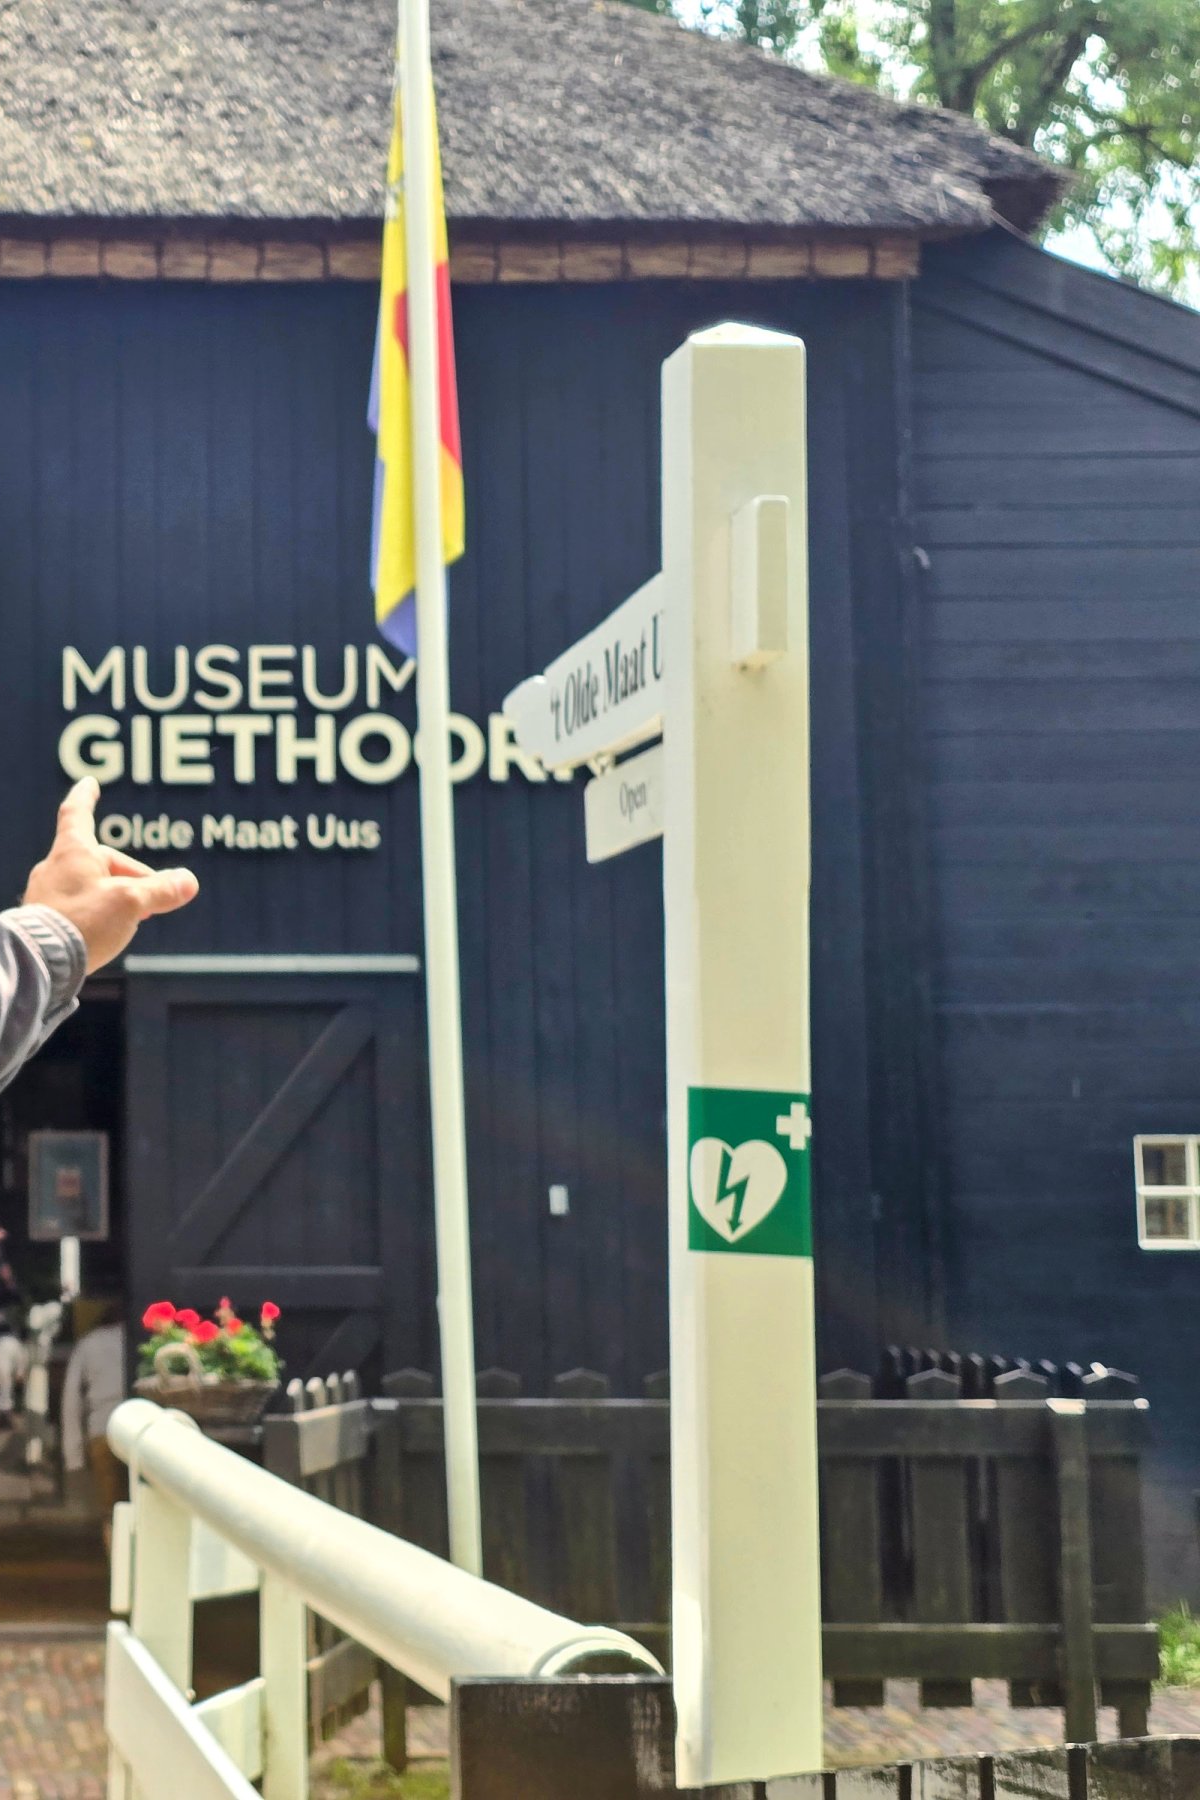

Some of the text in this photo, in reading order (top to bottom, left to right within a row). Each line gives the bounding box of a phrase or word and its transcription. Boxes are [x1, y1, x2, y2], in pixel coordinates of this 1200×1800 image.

[62, 644, 418, 712] MUSEUM
[564, 660, 599, 737] Olde
[602, 627, 647, 713] Maat
[58, 713, 612, 785] GIETHOOR
[99, 812, 382, 850] Olde Maat Uus
[619, 781, 648, 823] Open
